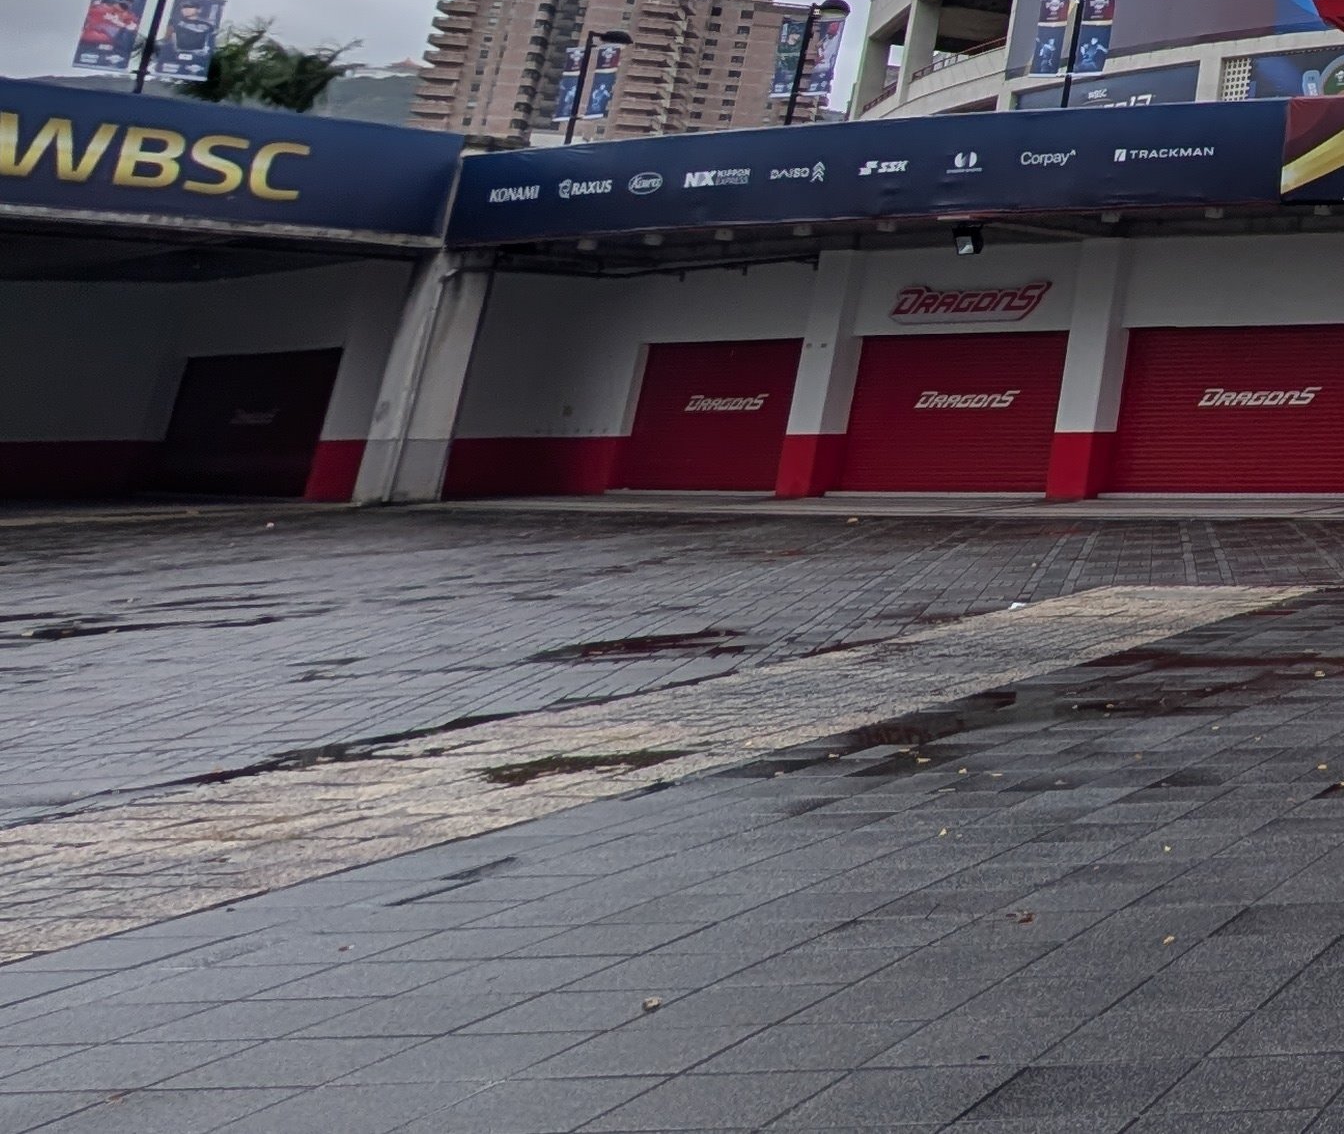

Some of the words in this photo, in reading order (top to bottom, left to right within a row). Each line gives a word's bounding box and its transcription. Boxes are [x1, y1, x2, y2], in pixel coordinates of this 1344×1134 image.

[0, 112, 311, 201] WBSC
[1020, 151, 1069, 166] Corpay
[1129, 146, 1215, 160] TRACKMAN
[770, 168, 810, 180] DAISO
[877, 161, 909, 173] SSK
[571, 179, 613, 196] RAXUS
[684, 170, 717, 188] NX
[489, 185, 540, 203] KONAMI
[893, 282, 1051, 316] DRAGONS
[684, 393, 769, 412] DRAGONS
[915, 390, 1020, 409] DRAGONS
[1198, 386, 1322, 407] DRAGONS
